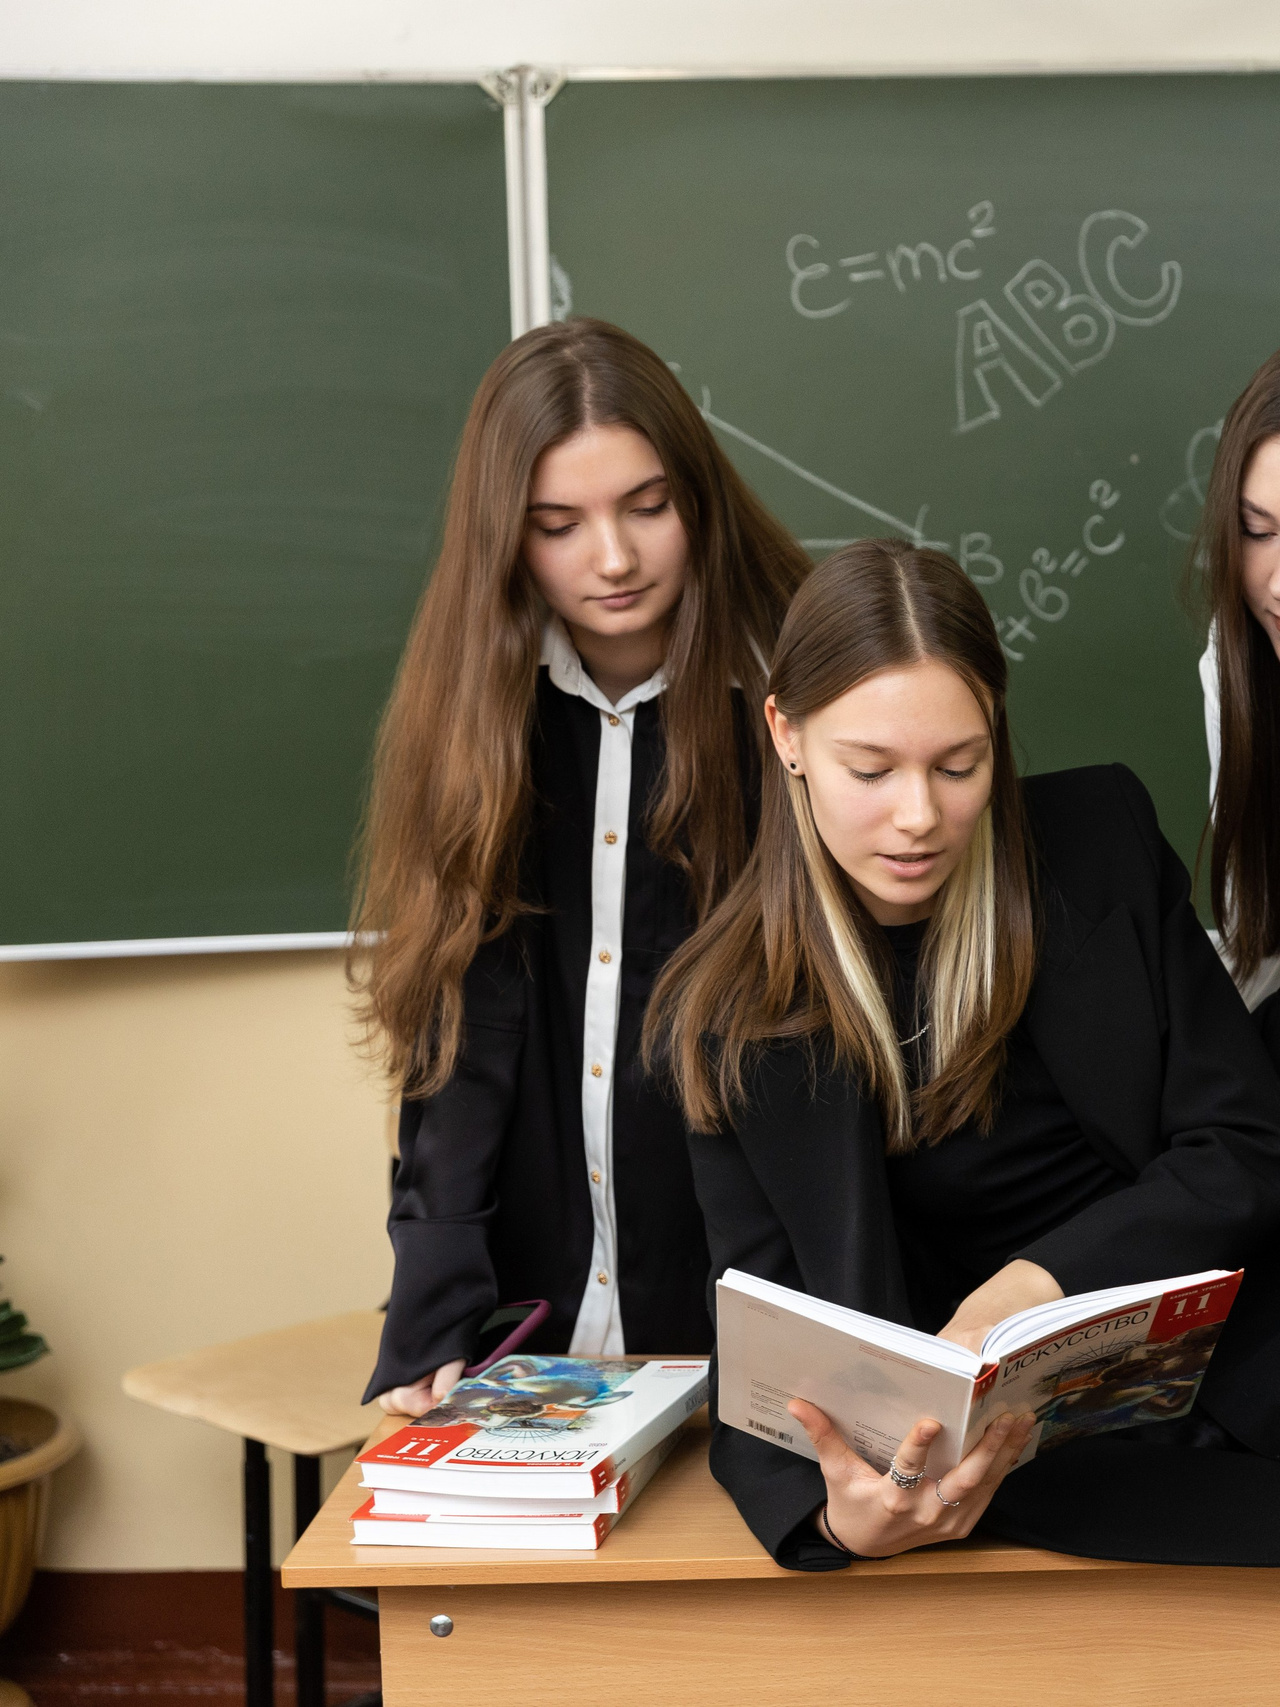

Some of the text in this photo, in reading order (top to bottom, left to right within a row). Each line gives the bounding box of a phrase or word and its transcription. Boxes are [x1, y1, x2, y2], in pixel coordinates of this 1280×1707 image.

[954, 208, 1182, 433] ABC
[1173, 1292, 1211, 1316] 11
[1003, 1310, 1150, 1379] ИСКУССТВО
[395, 1441, 441, 1456] 11
[455, 1447, 600, 1461] ИСКУССТВО
